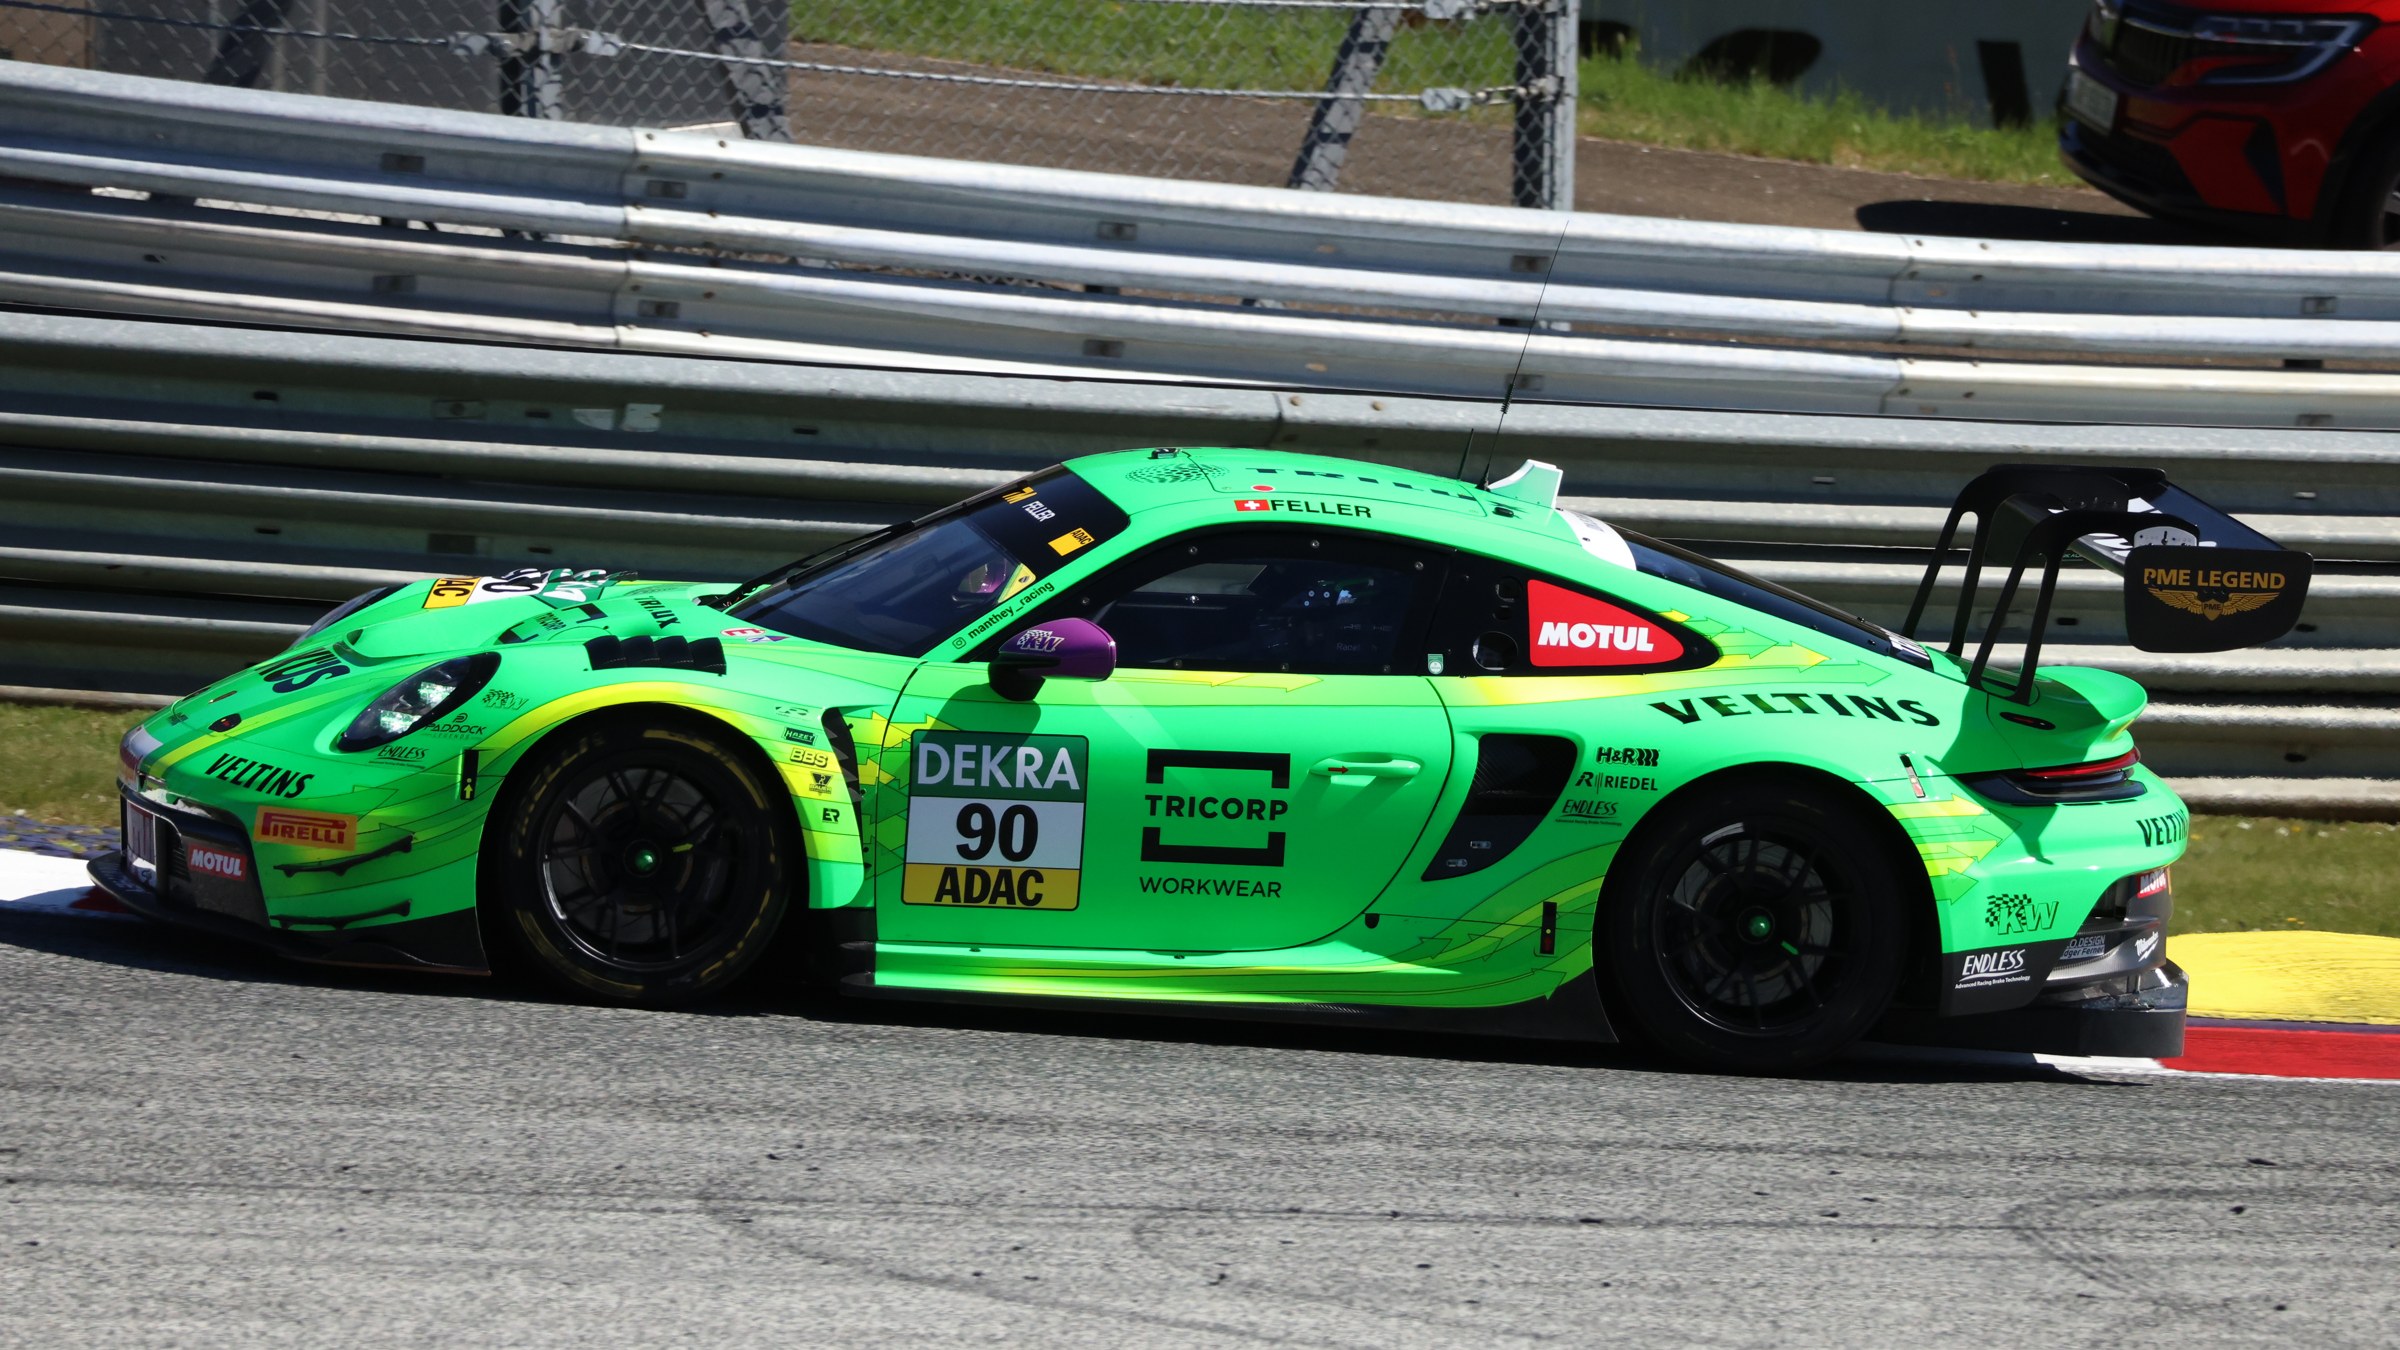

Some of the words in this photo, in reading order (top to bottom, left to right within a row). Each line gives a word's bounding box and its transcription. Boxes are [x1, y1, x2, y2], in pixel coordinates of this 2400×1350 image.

[1022, 500, 1056, 522] FELLER
[1271, 498, 1372, 519] FELLER
[1071, 528, 1093, 546] ADAC
[2143, 568, 2191, 586] PME
[2197, 570, 2286, 590] LEGEND
[967, 581, 1055, 639] manthey_racing
[2203, 603, 2222, 611] PME
[1537, 621, 1655, 653] MOTUL
[1648, 692, 1941, 727] VELTINS
[424, 723, 487, 735] PADDOCK
[785, 730, 813, 742] HAZET
[378, 745, 430, 760] ENDLESS
[790, 748, 828, 768] BBS
[1596, 747, 1635, 765] H&R
[204, 753, 315, 799] VELTINS
[917, 742, 1080, 790] DEKRA
[1604, 775, 1658, 791] RIEDEL
[1145, 794, 1288, 821] TRICORP
[1562, 799, 1619, 816] ENDLESS
[261, 812, 347, 844] PIRELLI
[956, 803, 1039, 862] 90
[191, 848, 242, 877] MOTUL
[934, 866, 1044, 906] ADAC
[1139, 876, 1281, 898] WORKWEAR
[1997, 900, 2060, 936] KW
[1961, 949, 2026, 976] ENDLESS
[1954, 981, 1976, 989] Advanced
[2005, 975, 2031, 983] Technology
